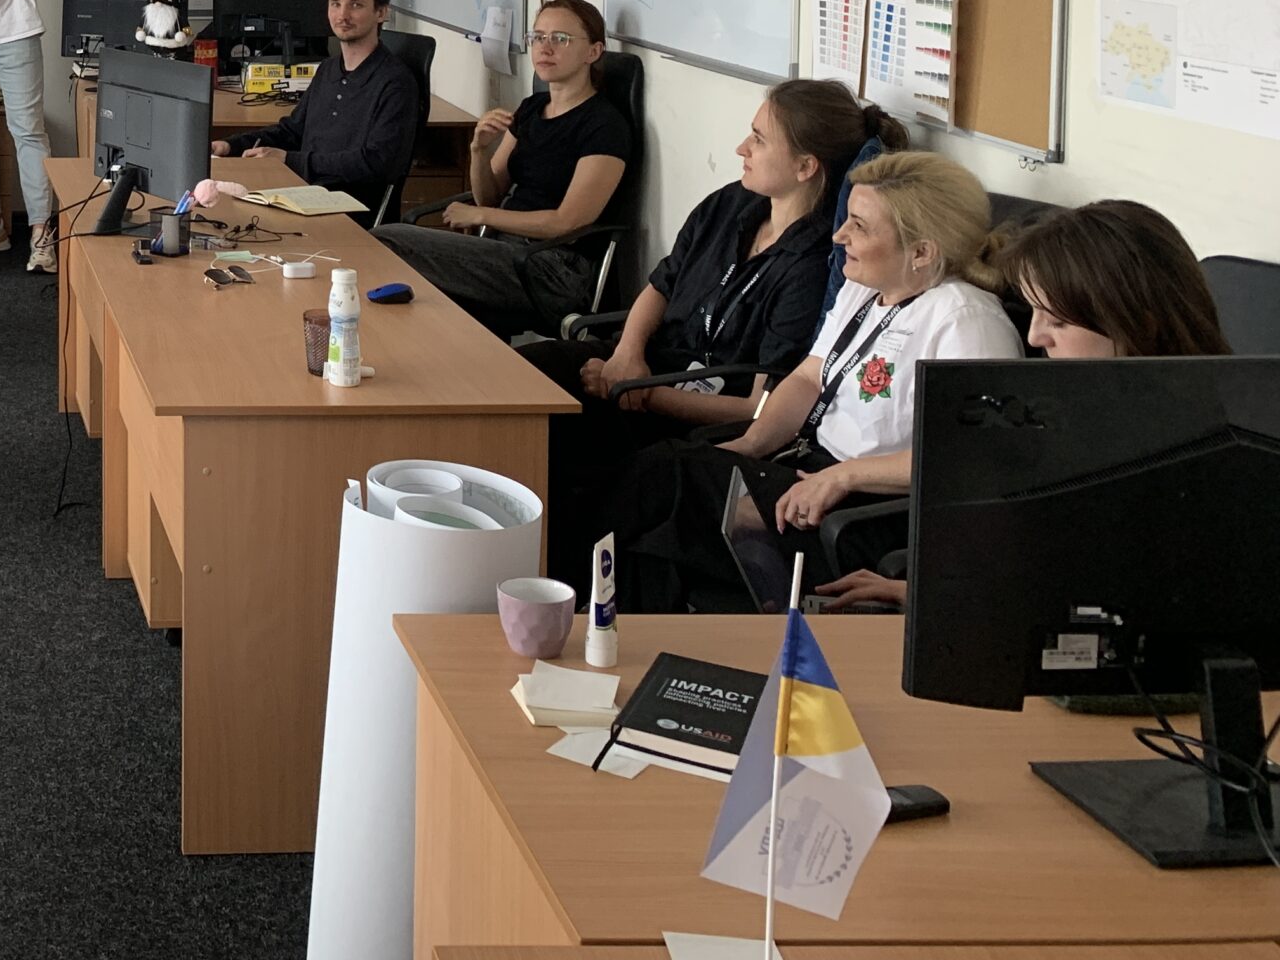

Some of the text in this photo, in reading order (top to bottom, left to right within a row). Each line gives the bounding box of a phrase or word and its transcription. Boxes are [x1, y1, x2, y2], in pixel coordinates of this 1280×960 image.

[880, 304, 901, 329] IMPACT
[823, 350, 839, 377] IMPACT
[841, 352, 860, 377] IMPACT
[809, 401, 827, 425] IMPACT
[670, 678, 754, 704] IMPACT
[703, 696, 742, 708] practices
[680, 724, 732, 741] USAID
